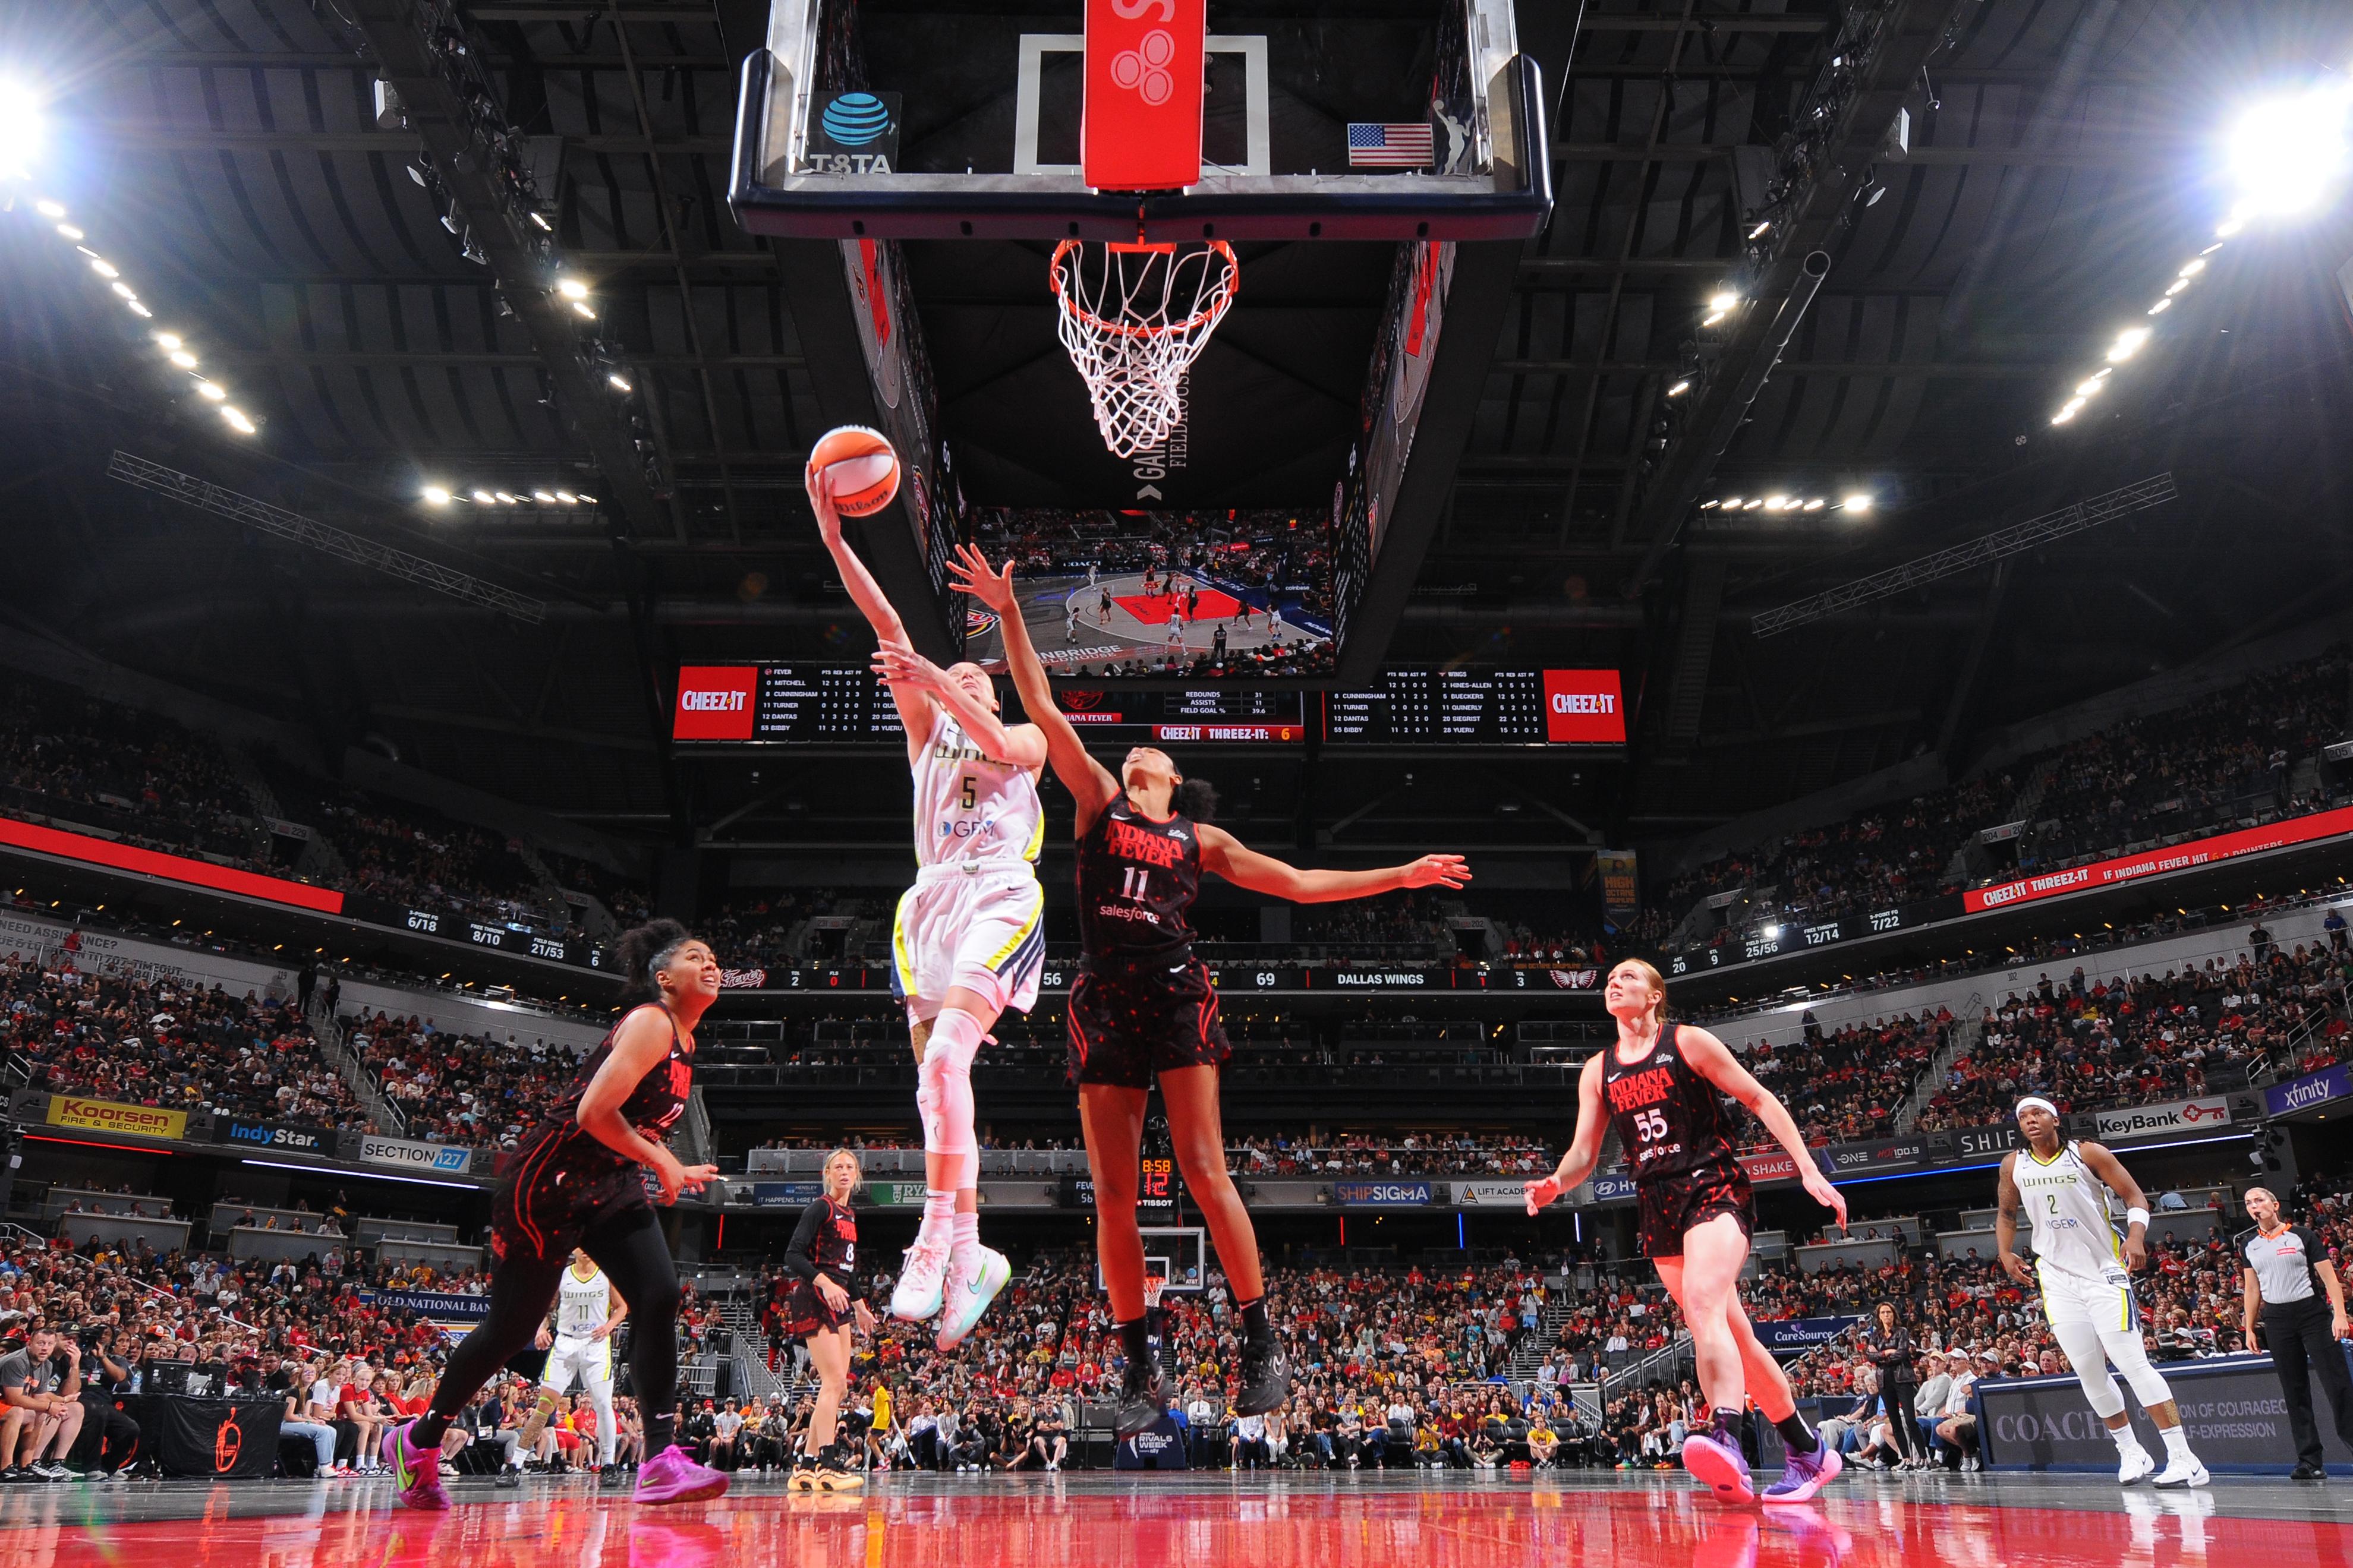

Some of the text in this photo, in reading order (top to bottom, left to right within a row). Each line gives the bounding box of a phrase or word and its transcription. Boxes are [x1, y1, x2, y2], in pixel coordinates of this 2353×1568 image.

[1209, 728, 1268, 740] THREEZ-IT:
[1281, 728, 1290, 740] 6
[2330, 747, 2348, 758] 205
[962, 777, 977, 810] 5
[1104, 820, 1183, 860] INDIANA
[1983, 832, 1998, 841] 204
[1108, 838, 1173, 869] FEVER
[2103, 853, 2209, 880] IF INDIANA FEVER HIT
[1120, 867, 1148, 901] 11
[2031, 869, 2088, 892] THREEZ-IT
[1100, 904, 1160, 924] salesforce
[408, 917, 436, 932] 6/18
[484, 926, 505, 935] THROWS
[1817, 923, 1838, 931] THROWS
[1871, 916, 1900, 931] 7/22
[34, 926, 118, 949] ASSISANCE?
[473, 932, 500, 945] 8/10
[1806, 928, 1839, 945] 12/14
[531, 944, 564, 958] 21/53
[1746, 942, 1778, 958] 25/56
[592, 957, 599, 966] 6
[1711, 954, 1718, 965] 9
[277, 970, 287, 980] 119
[1672, 962, 1686, 973] 20
[792, 977, 799, 986] 2
[830, 977, 837, 986] 0
[1043, 973, 1061, 985] 56
[1211, 977, 1218, 986] 4
[1256, 973, 1424, 985] 69 DALLAS WINGS
[1480, 977, 1485, 986] 1
[1517, 977, 1524, 986] 3
[2008, 972, 2018, 981] 102
[1655, 1053, 1674, 1064] Lilly
[1608, 1066, 1674, 1103] INDIANA
[1616, 1085, 1668, 1112] FEVER
[2285, 1078, 2330, 1108] xfinity
[62, 1100, 169, 1127] Koorsen
[61, 1116, 86, 1125] FIRE
[108, 1121, 166, 1134] SECURITY
[1633, 1108, 1668, 1142] 55
[2099, 1110, 2181, 1134] KeyBank
[364, 1144, 462, 1166] SECTION 127
[1143, 1160, 1170, 1172] 8:58
[1752, 1160, 1794, 1175] SHAKE
[903, 1185, 927, 1197] RYA
[1076, 1181, 1094, 1190] FEVE
[1146, 1173, 1168, 1195] 12
[1338, 1186, 1428, 1201] SHIPSIGMA
[2047, 1195, 2058, 1214] 2
[2051, 1219, 2078, 1229] GEM
[846, 1243, 854, 1261] 8
[378, 1296, 490, 1313] OLD NATIONAL BAN
[579, 1305, 588, 1320] 11
[1775, 1330, 1832, 1341] CareSource
[2200, 1404, 2215, 1417] OF
[2217, 1399, 2288, 1416] COURAGEO
[1996, 1410, 2106, 1443] COACH
[2185, 1422, 2276, 1439] LF-EXPRESSION
